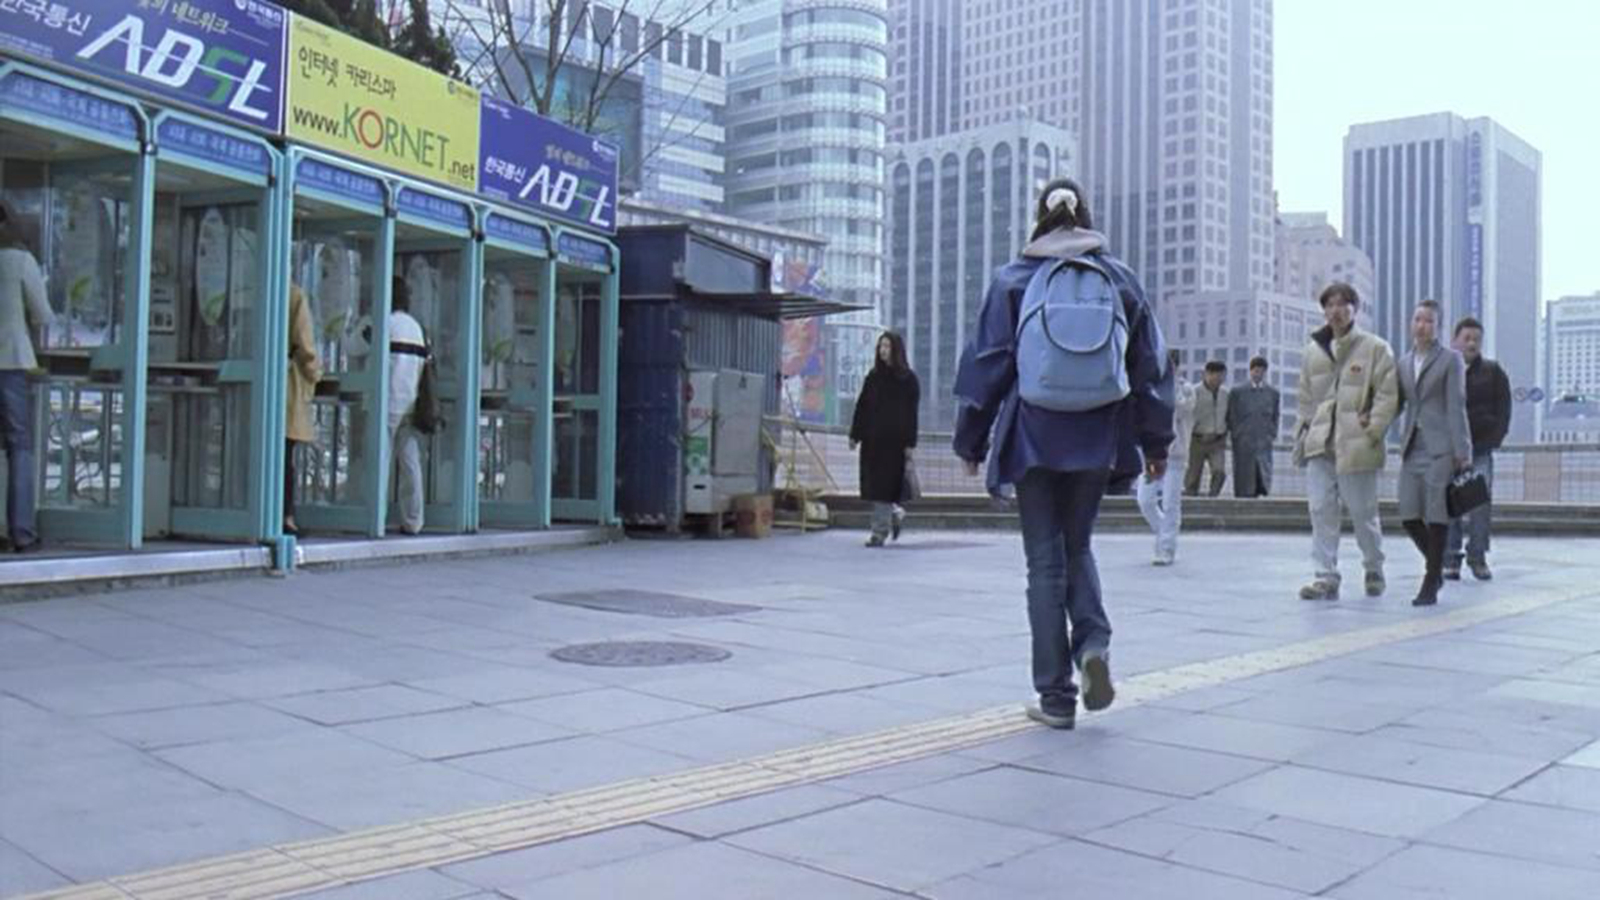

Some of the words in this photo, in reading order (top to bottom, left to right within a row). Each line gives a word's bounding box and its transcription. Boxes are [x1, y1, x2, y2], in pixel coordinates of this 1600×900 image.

[172, 2, 229, 34] 네트워크
[76, 14, 270, 119] ADSL
[299, 46, 339, 88] 인터넷
[346, 63, 397, 100] 카리스마
[293, 102, 475, 181] www.KORNET.net
[519, 164, 611, 227] ADSL
